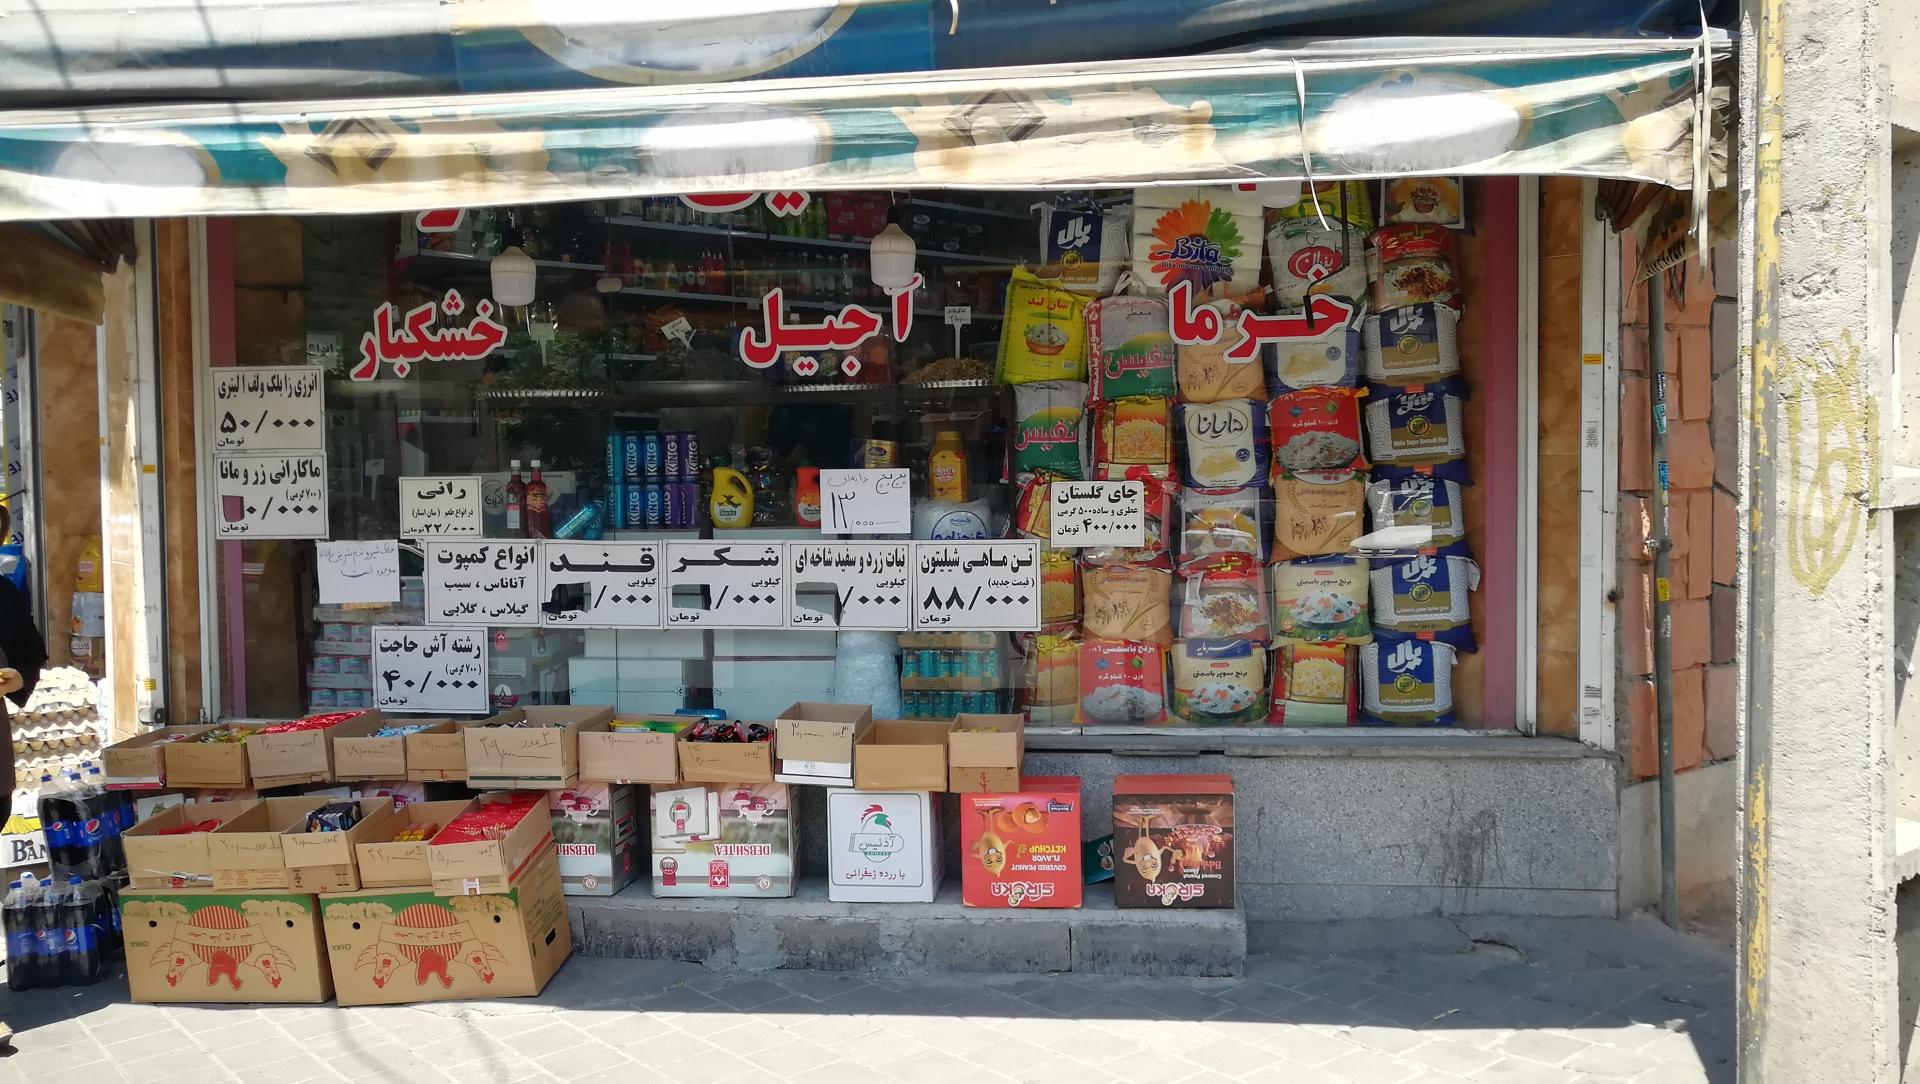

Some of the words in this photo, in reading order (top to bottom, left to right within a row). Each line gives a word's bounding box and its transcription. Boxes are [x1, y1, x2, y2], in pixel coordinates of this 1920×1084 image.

[1169, 237, 1220, 263] Bita
[1168, 263, 1354, 364] خرما
[351, 289, 507, 381] خشکبار
[1104, 343, 1172, 379] نفیس
[218, 373, 240, 399] لیتری
[248, 374, 265, 398] ولف
[266, 374, 283, 398] بلک
[294, 373, 318, 398] انرژی
[220, 410, 315, 434] ۵۰/۰۰۰
[217, 437, 245, 447] تومان
[1014, 416, 1078, 451] نفیس
[627, 442, 637, 476] KING
[646, 442, 658, 476] KING
[666, 442, 678, 476] KING
[219, 460, 240, 480] مانا
[241, 468, 249, 485] و
[252, 462, 266, 485] زر
[269, 459, 321, 485] ماکارانی
[417, 481, 467, 500] رانی
[1057, 484, 1104, 504] گلستان
[1107, 484, 1138, 503] چای
[246, 496, 319, 520] ۰/۰۰۰
[628, 491, 639, 525] KING
[647, 491, 658, 525] KING
[1057, 506, 1077, 517] گرمی
[1110, 508, 1115, 516] و
[1116, 506, 1138, 517] عطری
[221, 523, 249, 533] تومان
[404, 526, 424, 534] تومان
[424, 523, 475, 534] ۲۲/۰۰۰
[1057, 523, 1080, 535] تومان
[1082, 518, 1137, 535] ۴۰۰/۰۰۰
[437, 545, 489, 570] کمپوت
[494, 545, 535, 569] انواع
[549, 546, 656, 574] قند
[671, 546, 780, 573] شکر
[811, 548, 834, 572] شاخه
[835, 550, 857, 571] سفید
[858, 556, 865, 574] و
[866, 551, 885, 573] زرد
[885, 549, 906, 571] نبات
[920, 548, 961, 573] شیلیتون
[963, 549, 1009, 574] ماهی
[1009, 548, 1033, 573] تن
[444, 579, 472, 591] سیب
[484, 576, 527, 592] آناناس
[627, 577, 657, 588] کیلویی
[750, 577, 781, 589] کیلویی
[876, 577, 906, 589] کیلویی
[922, 586, 1030, 611] ۸۸/۰۰۰
[442, 602, 477, 617] گلابی
[489, 602, 528, 617] گیلاس
[547, 610, 578, 621] تومان
[669, 611, 700, 623] تومان
[793, 612, 823, 623] تومان
[919, 613, 951, 624] تومان
[379, 636, 418, 653] حاجت
[423, 633, 446, 658] آش
[451, 636, 481, 660] رشته
[382, 669, 479, 694] ۴۰/۰۰۰
[379, 696, 408, 706] تومان
[563, 844, 595, 856] DEBSH
[714, 844, 736, 856] TEA
[736, 844, 771, 856] DEBSH
[1028, 844, 1067, 854] KETCHUP
[1031, 854, 1060, 862] FLAVOR
[845, 867, 878, 880] زعفرانی
[898, 869, 906, 880] با
[1011, 863, 1037, 872] PEANUT
[1037, 863, 1067, 871] COVERED
